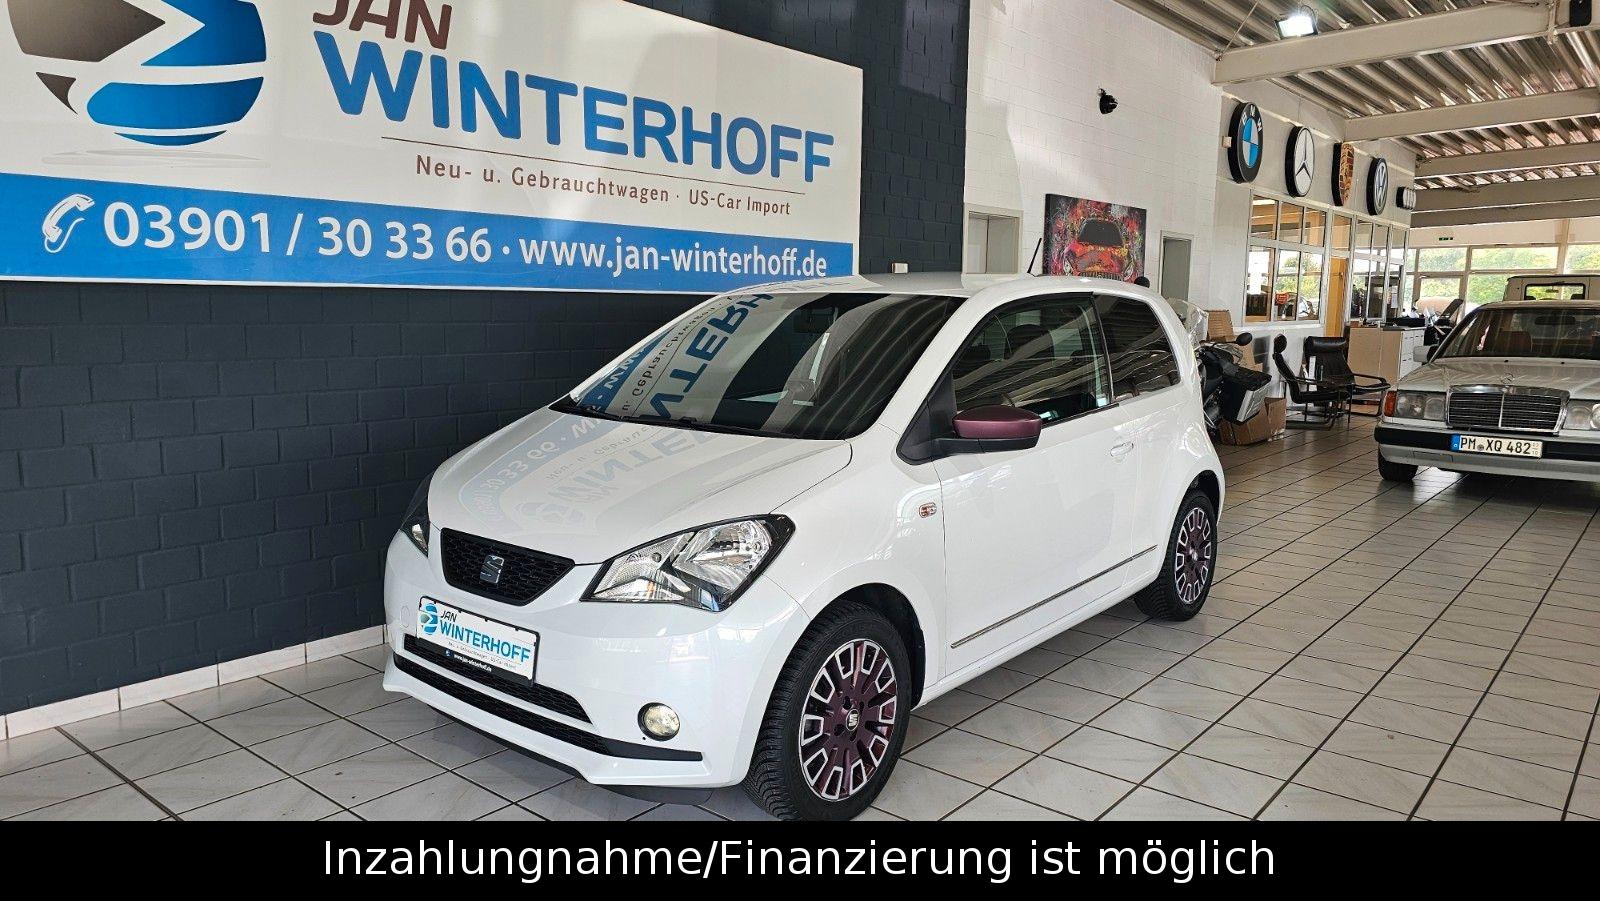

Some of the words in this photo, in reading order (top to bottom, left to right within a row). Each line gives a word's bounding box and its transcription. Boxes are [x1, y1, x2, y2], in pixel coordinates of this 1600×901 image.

[313, 31, 834, 183] WINTERHOFF
[416, 154, 472, 179] Neu-
[483, 168, 501, 183] u.
[511, 167, 669, 204] Gebrauchtwagen
[689, 189, 742, 210] US-Car
[747, 196, 791, 216] Import
[103, 201, 270, 253] 03901
[318, 216, 372, 257] 30
[386, 221, 434, 260] 33
[446, 226, 492, 263] 66
[519, 236, 827, 277] www.jan-winterhoff.de
[1460, 437, 1476, 450] PM
[1486, 439, 1502, 453] XQ
[1506, 441, 1531, 455] 482
[440, 610, 458, 623] JAN
[440, 619, 531, 663] WINTERHOFF
